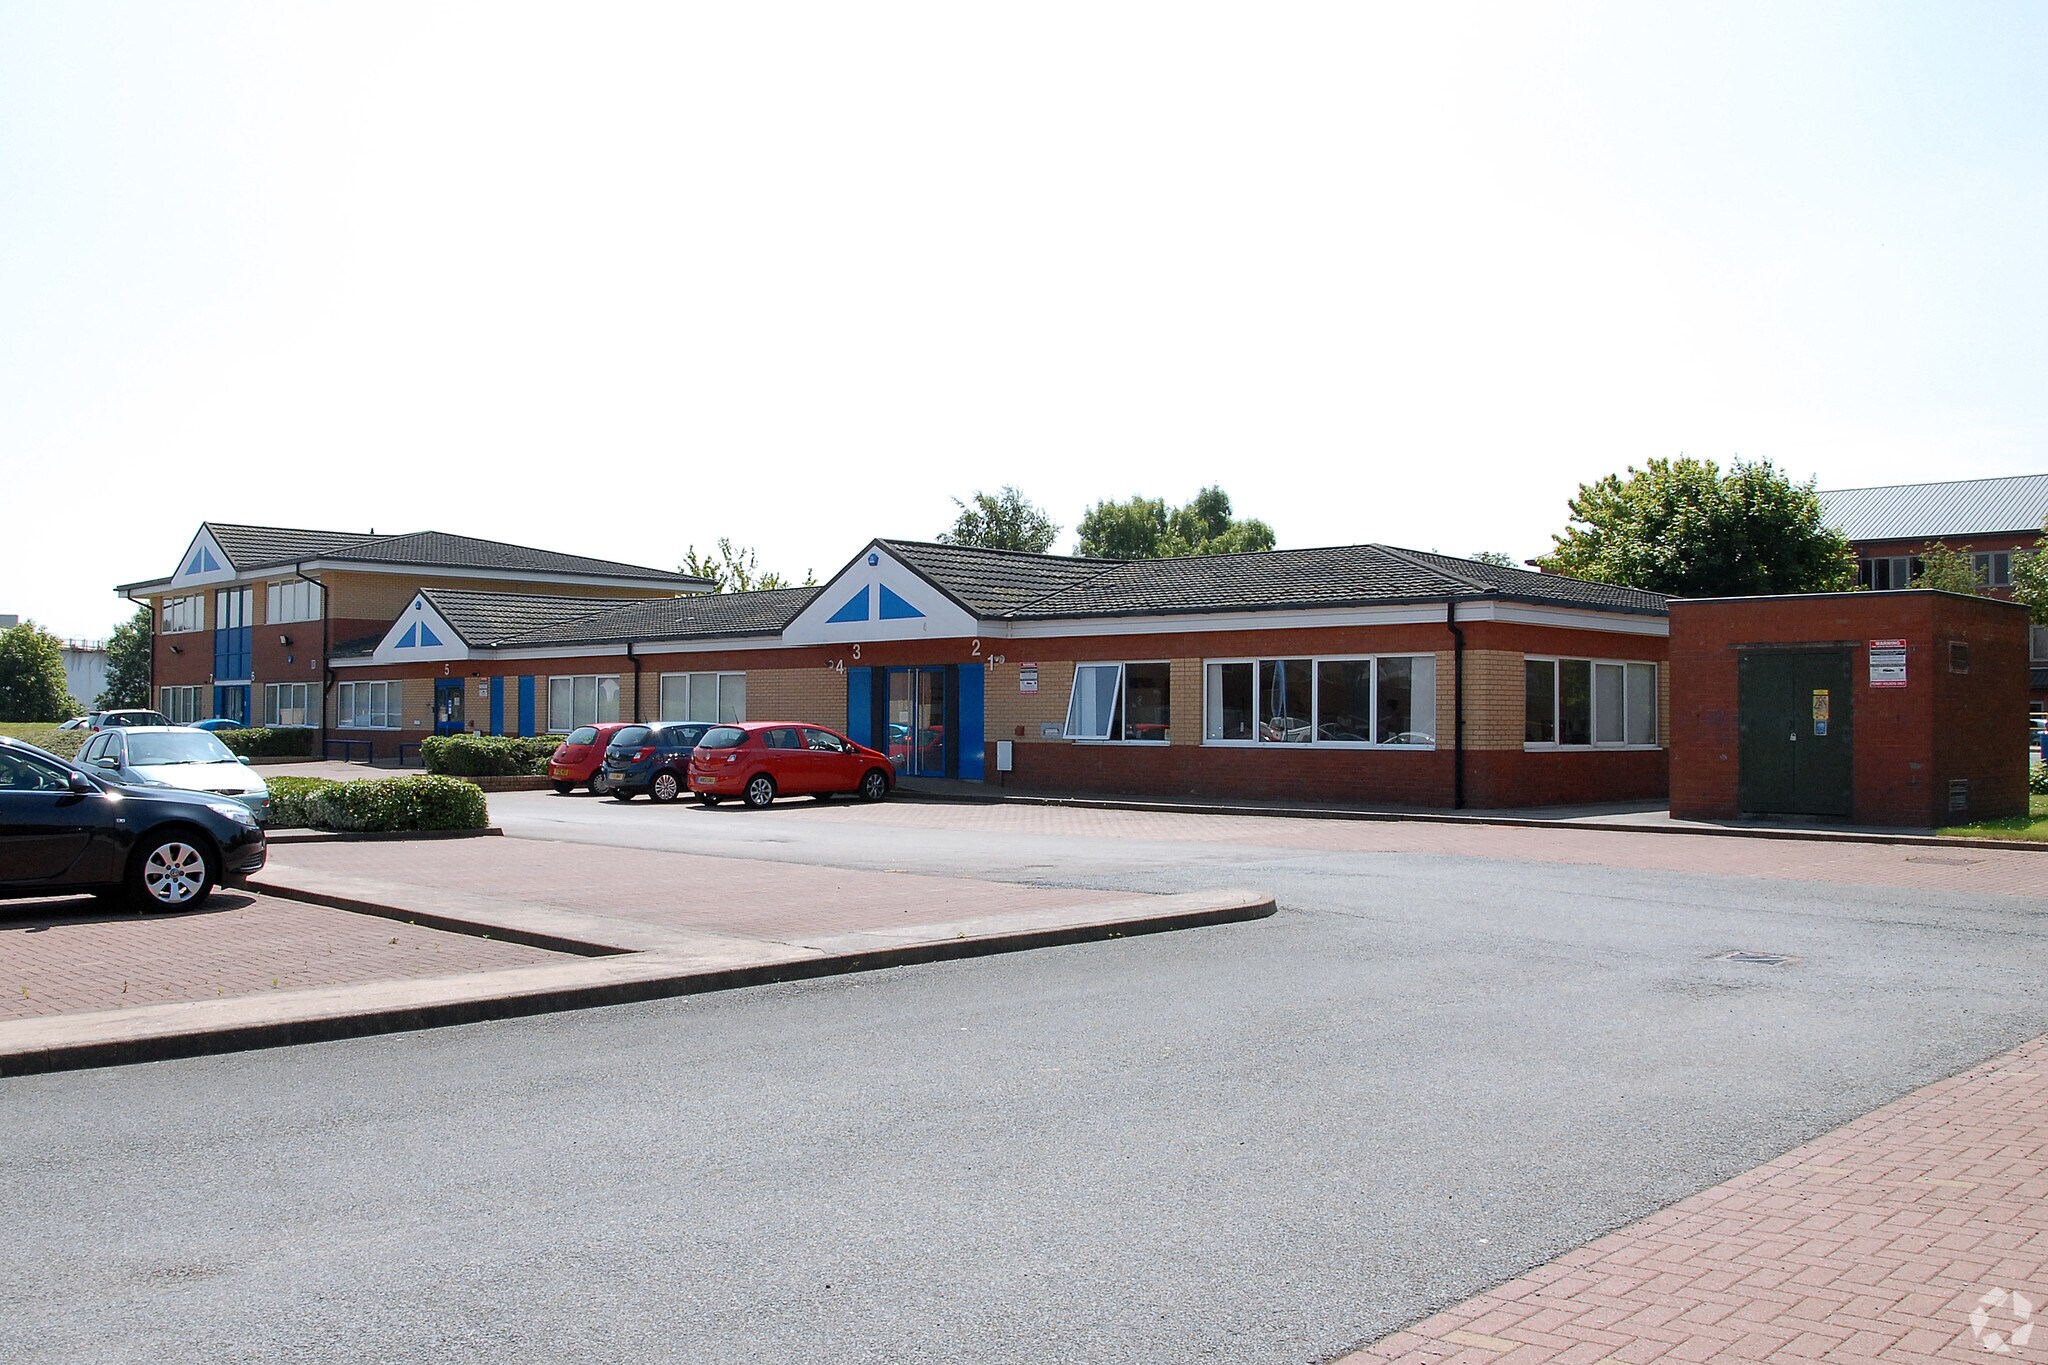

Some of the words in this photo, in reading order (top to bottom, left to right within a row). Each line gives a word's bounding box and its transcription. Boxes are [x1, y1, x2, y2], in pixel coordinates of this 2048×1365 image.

[852, 643, 861, 660] 3
[971, 639, 981, 656] 2
[444, 663, 450, 676] 5
[835, 659, 844, 675] 4
[987, 654, 994, 672] 1
